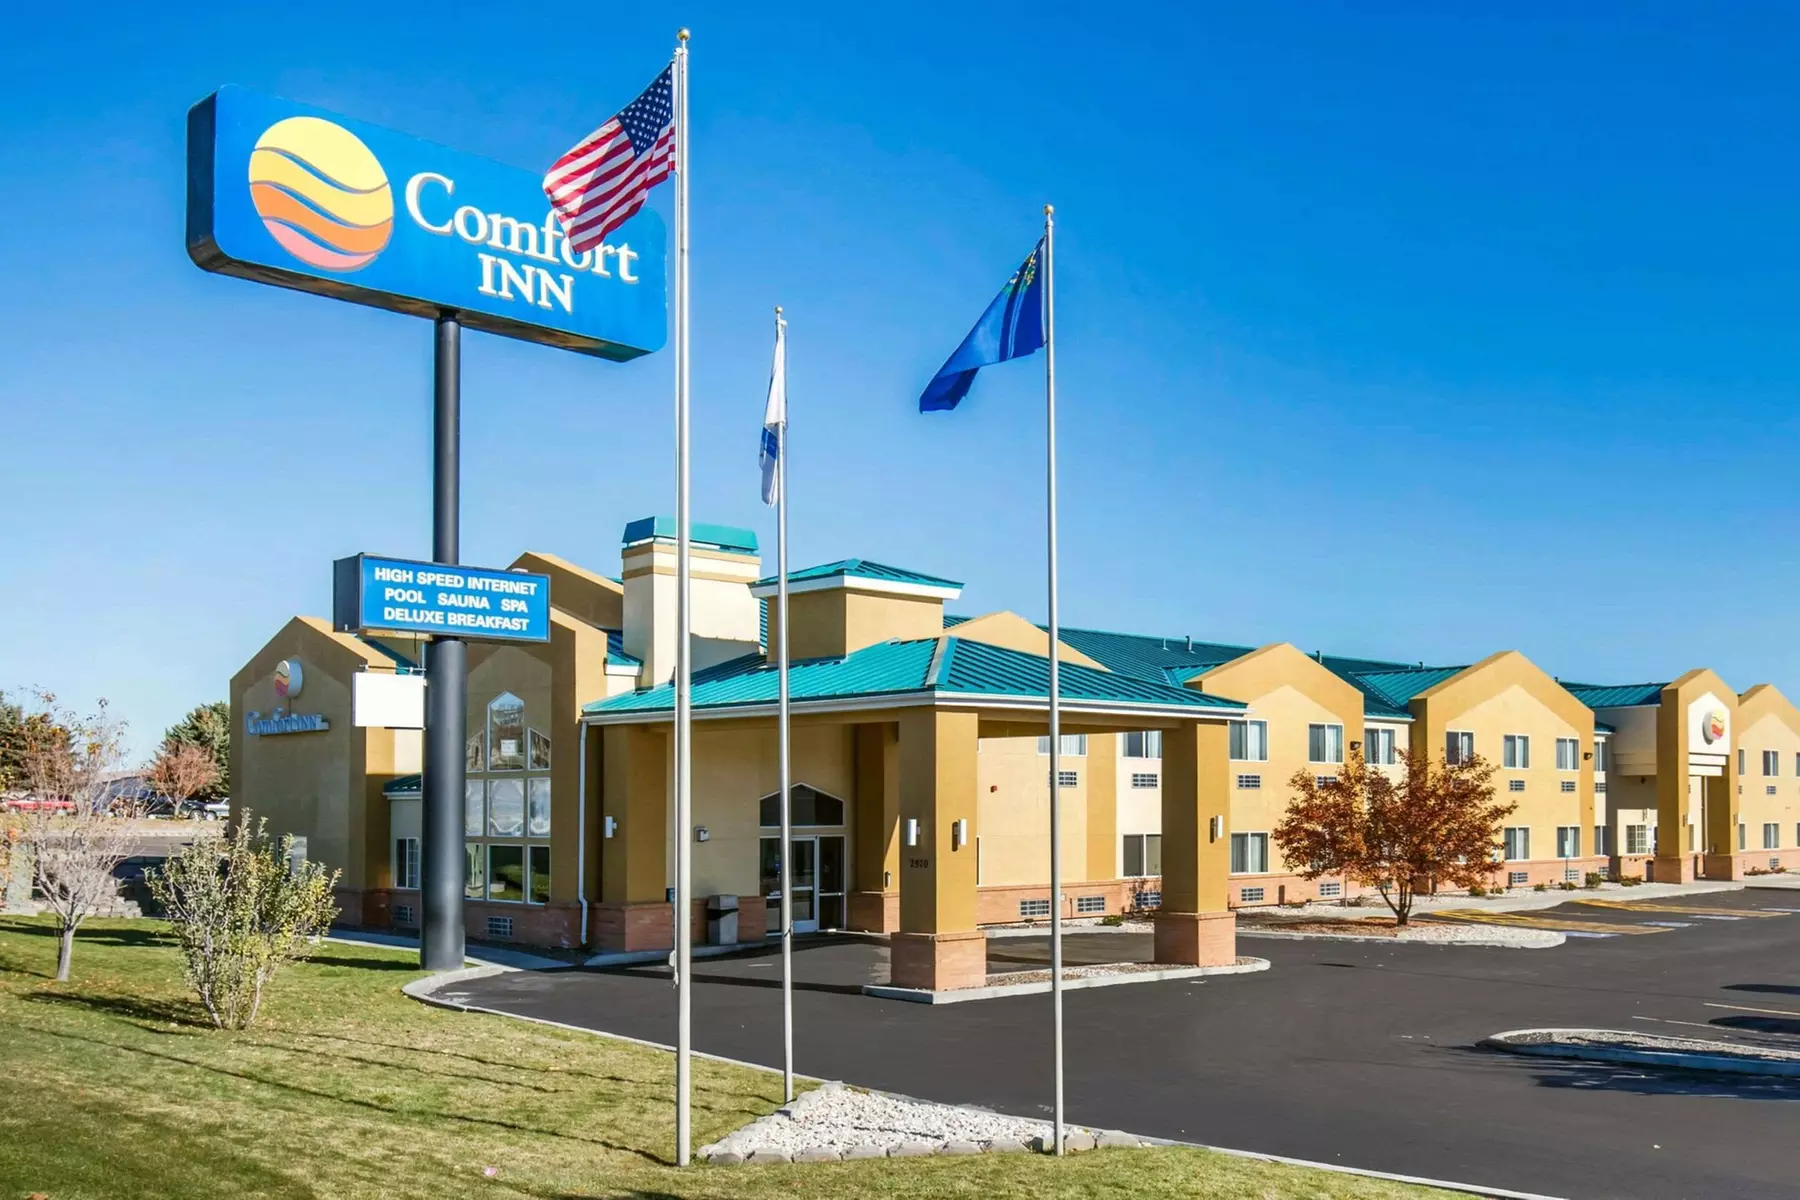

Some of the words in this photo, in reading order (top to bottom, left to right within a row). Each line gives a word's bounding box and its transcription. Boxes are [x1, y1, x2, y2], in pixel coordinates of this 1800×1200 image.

[405, 172, 638, 283] Comfort
[477, 252, 574, 313] INN
[375, 567, 413, 584] HIGH
[416, 571, 464, 588] SPEED
[467, 576, 537, 596] INTERNET
[384, 588, 426, 604] POOL
[437, 593, 490, 610] SAUNA
[501, 598, 528, 613] SPA
[384, 607, 444, 624] DELUXE
[447, 612, 529, 632] BREAKFAST
